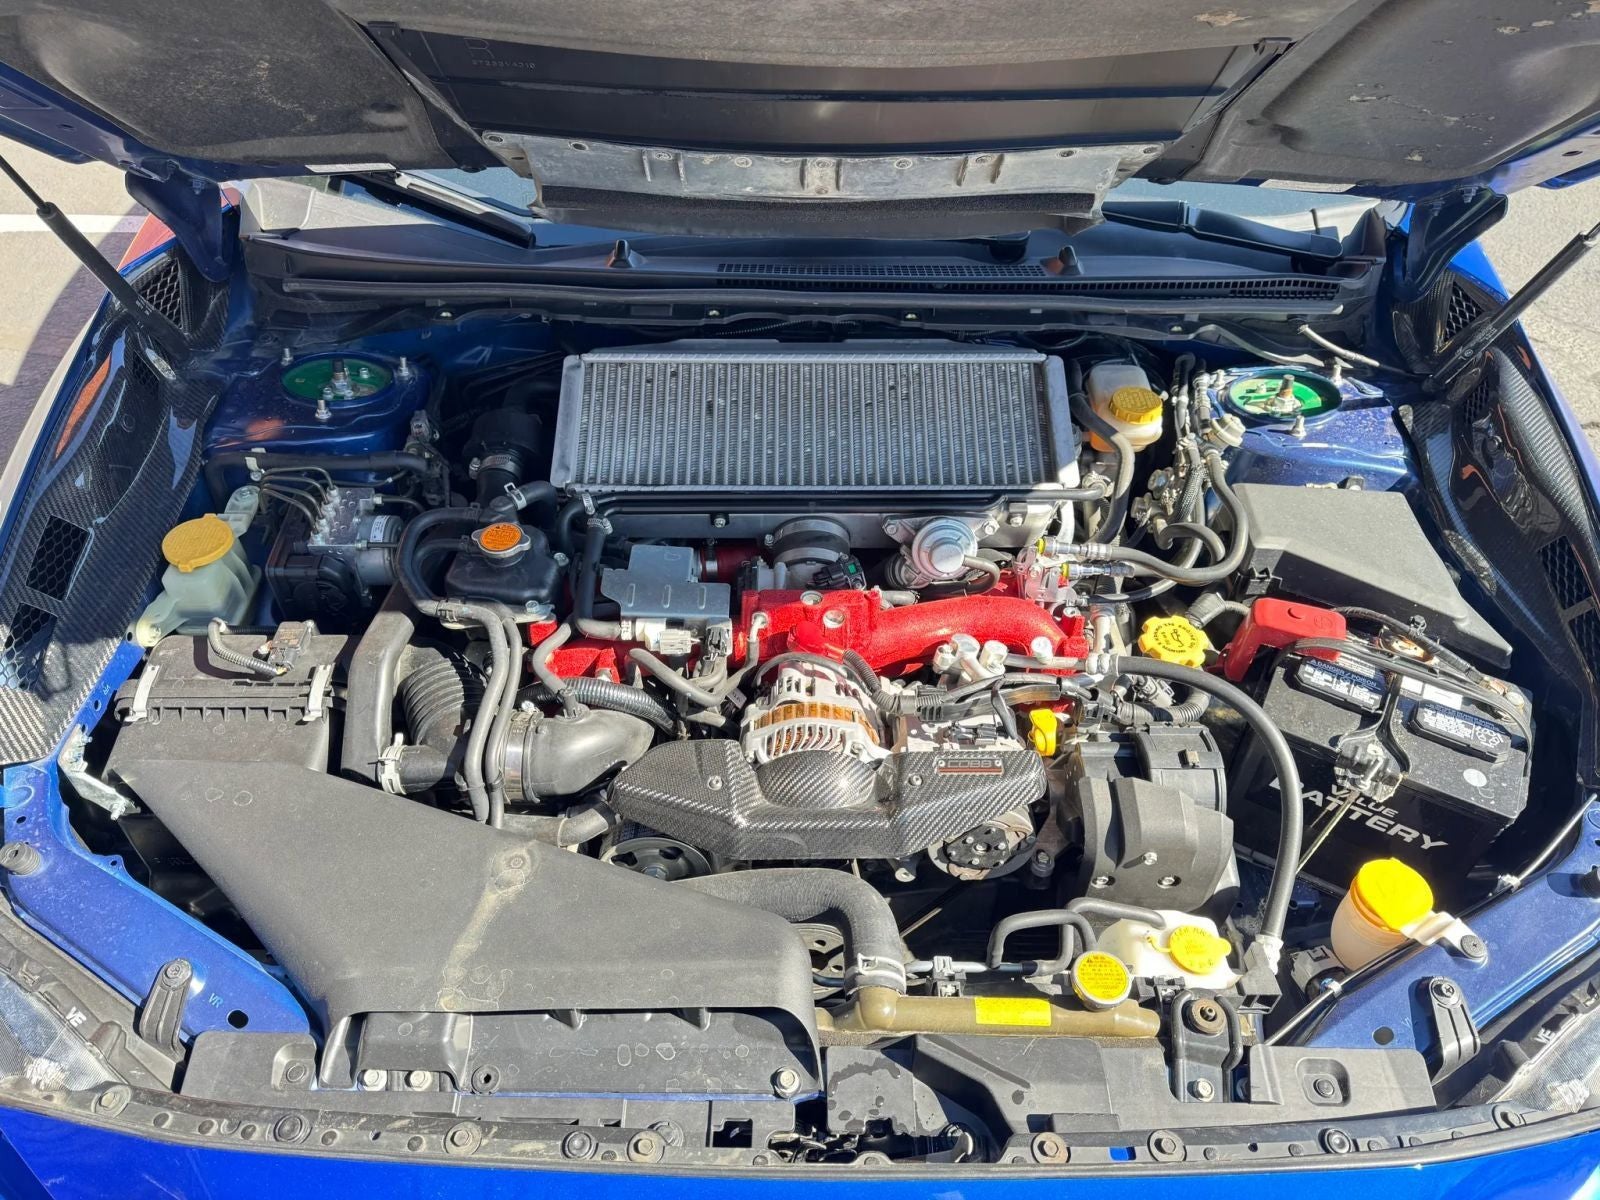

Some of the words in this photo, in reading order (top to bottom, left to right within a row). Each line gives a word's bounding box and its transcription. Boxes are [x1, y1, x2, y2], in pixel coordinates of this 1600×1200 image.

[947, 759, 993, 769] COBB
[1331, 783, 1399, 818] VLUE
[65, 1005, 87, 1028] VE
